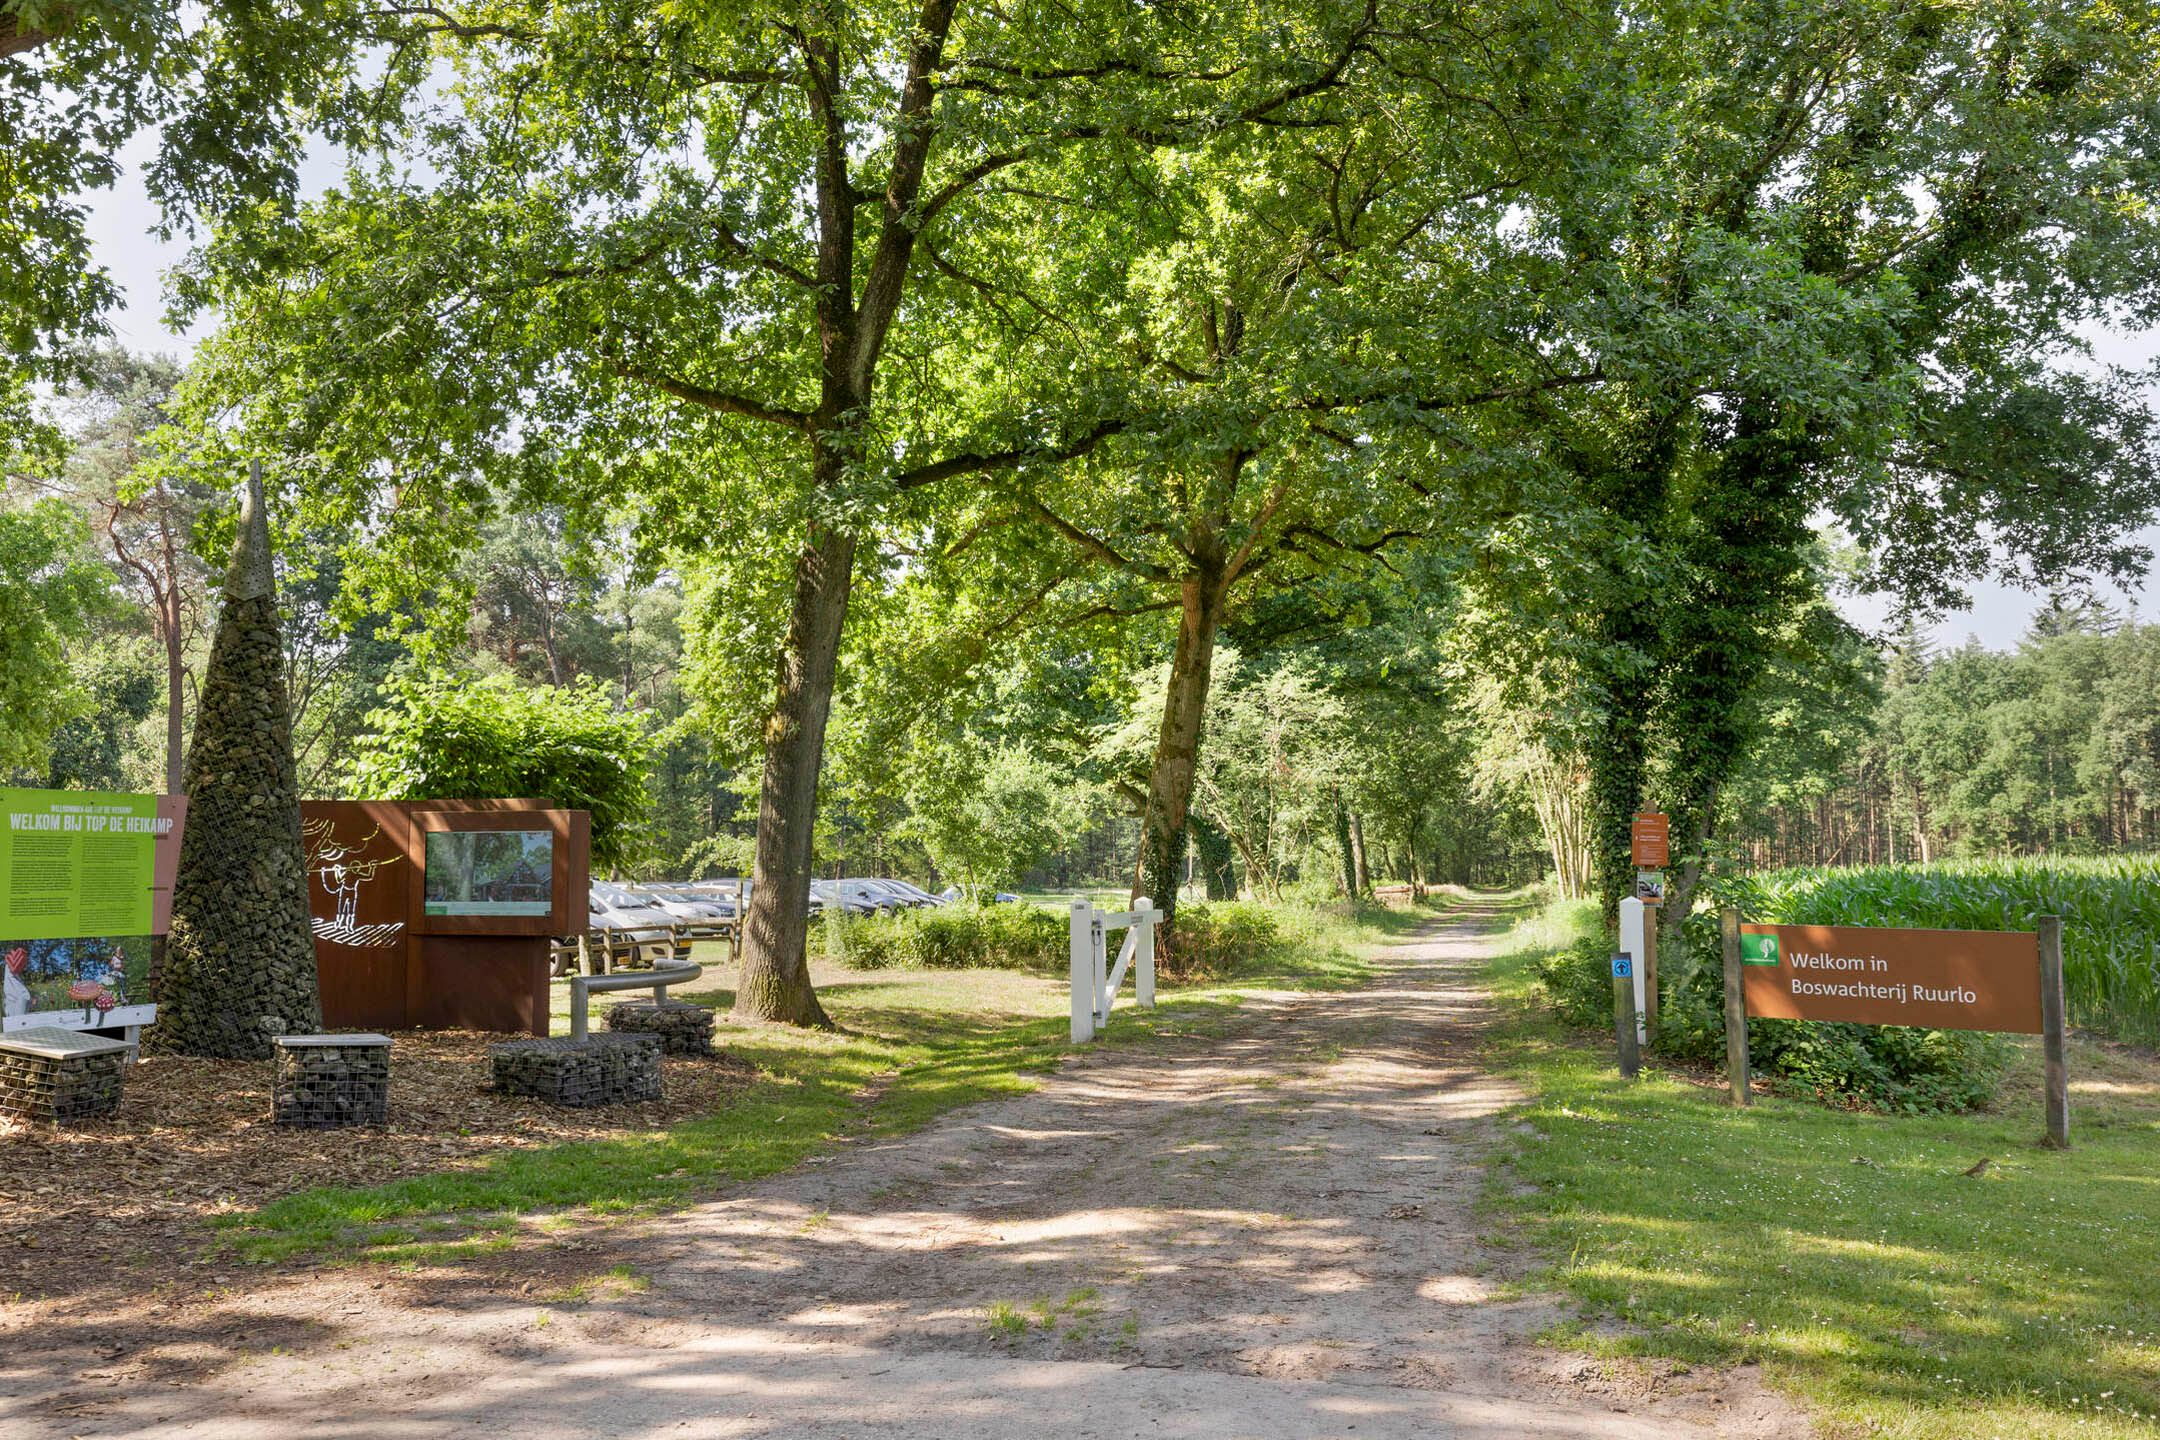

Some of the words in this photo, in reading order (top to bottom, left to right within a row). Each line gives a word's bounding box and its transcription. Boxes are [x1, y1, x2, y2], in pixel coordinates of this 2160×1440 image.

[10, 813, 61, 831] WELKOM
[64, 815, 82, 832] BIJ
[86, 815, 106, 832] TOP
[109, 816, 123, 832] DE
[126, 816, 173, 833] HEIKAMP
[1790, 953, 1865, 971] Welkom
[1870, 956, 1888, 972] in
[1792, 979, 1906, 1004] Boswachterij
[1913, 985, 1976, 1004] Ruurlo
